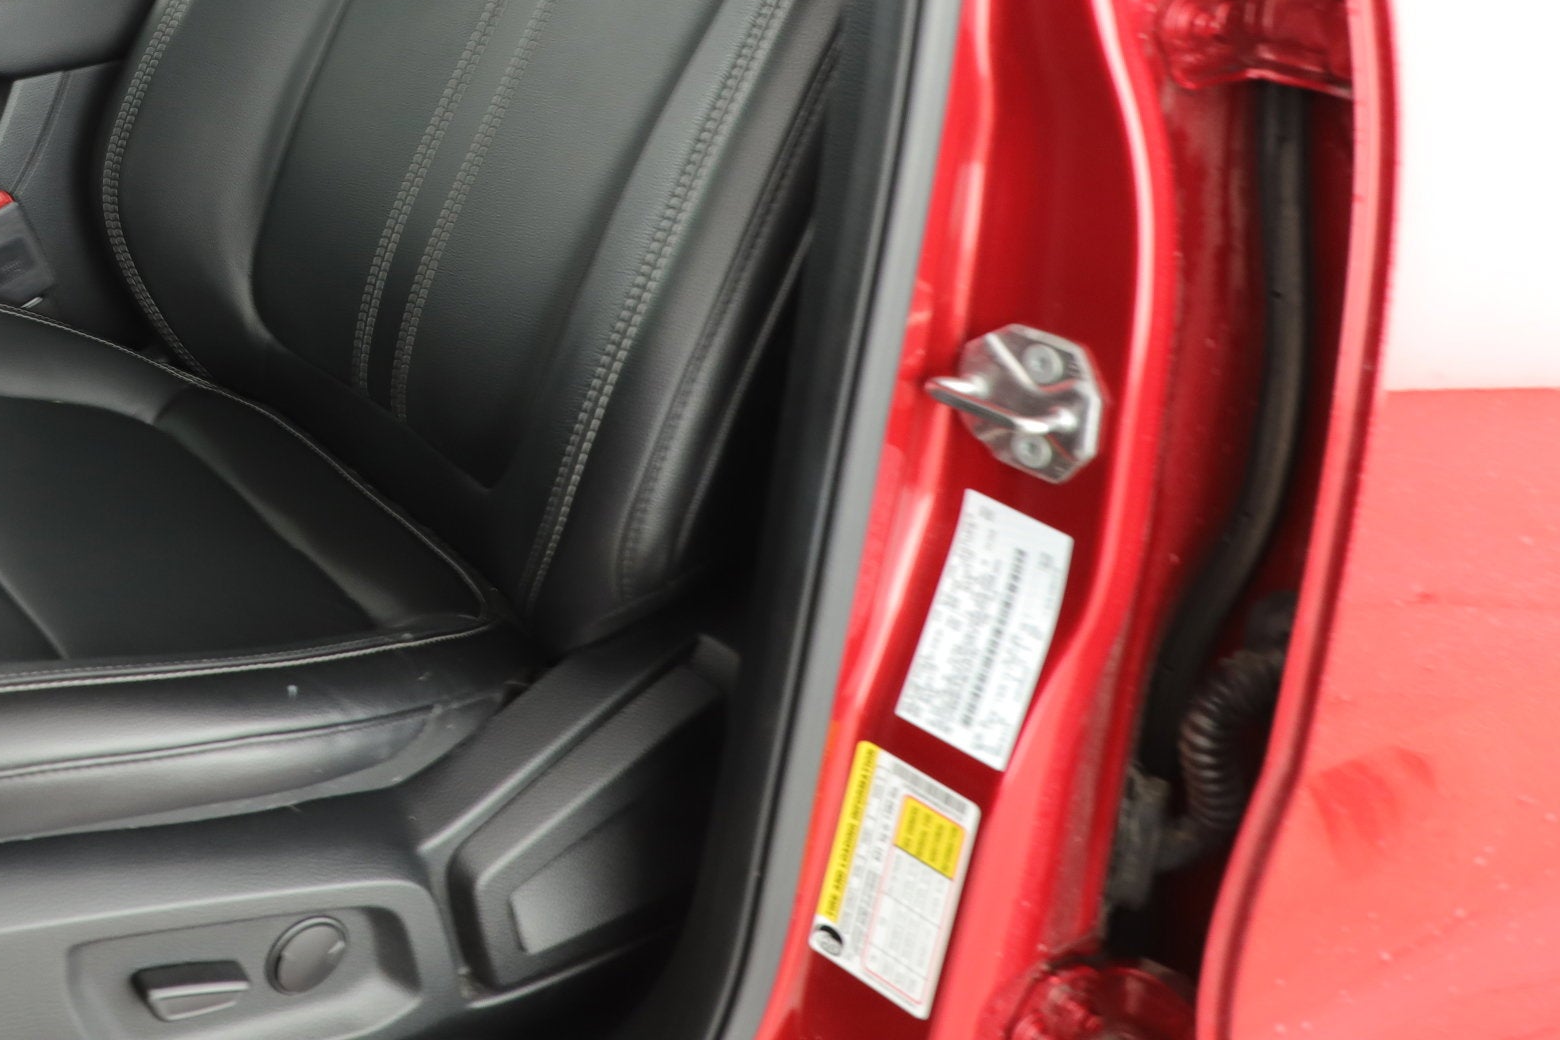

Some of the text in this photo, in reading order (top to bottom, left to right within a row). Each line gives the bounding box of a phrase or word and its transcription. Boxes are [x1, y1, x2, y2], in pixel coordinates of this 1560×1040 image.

[832, 869, 845, 891] AND
[839, 822, 858, 867] LOADING
[850, 748, 876, 820] INFORMATION
